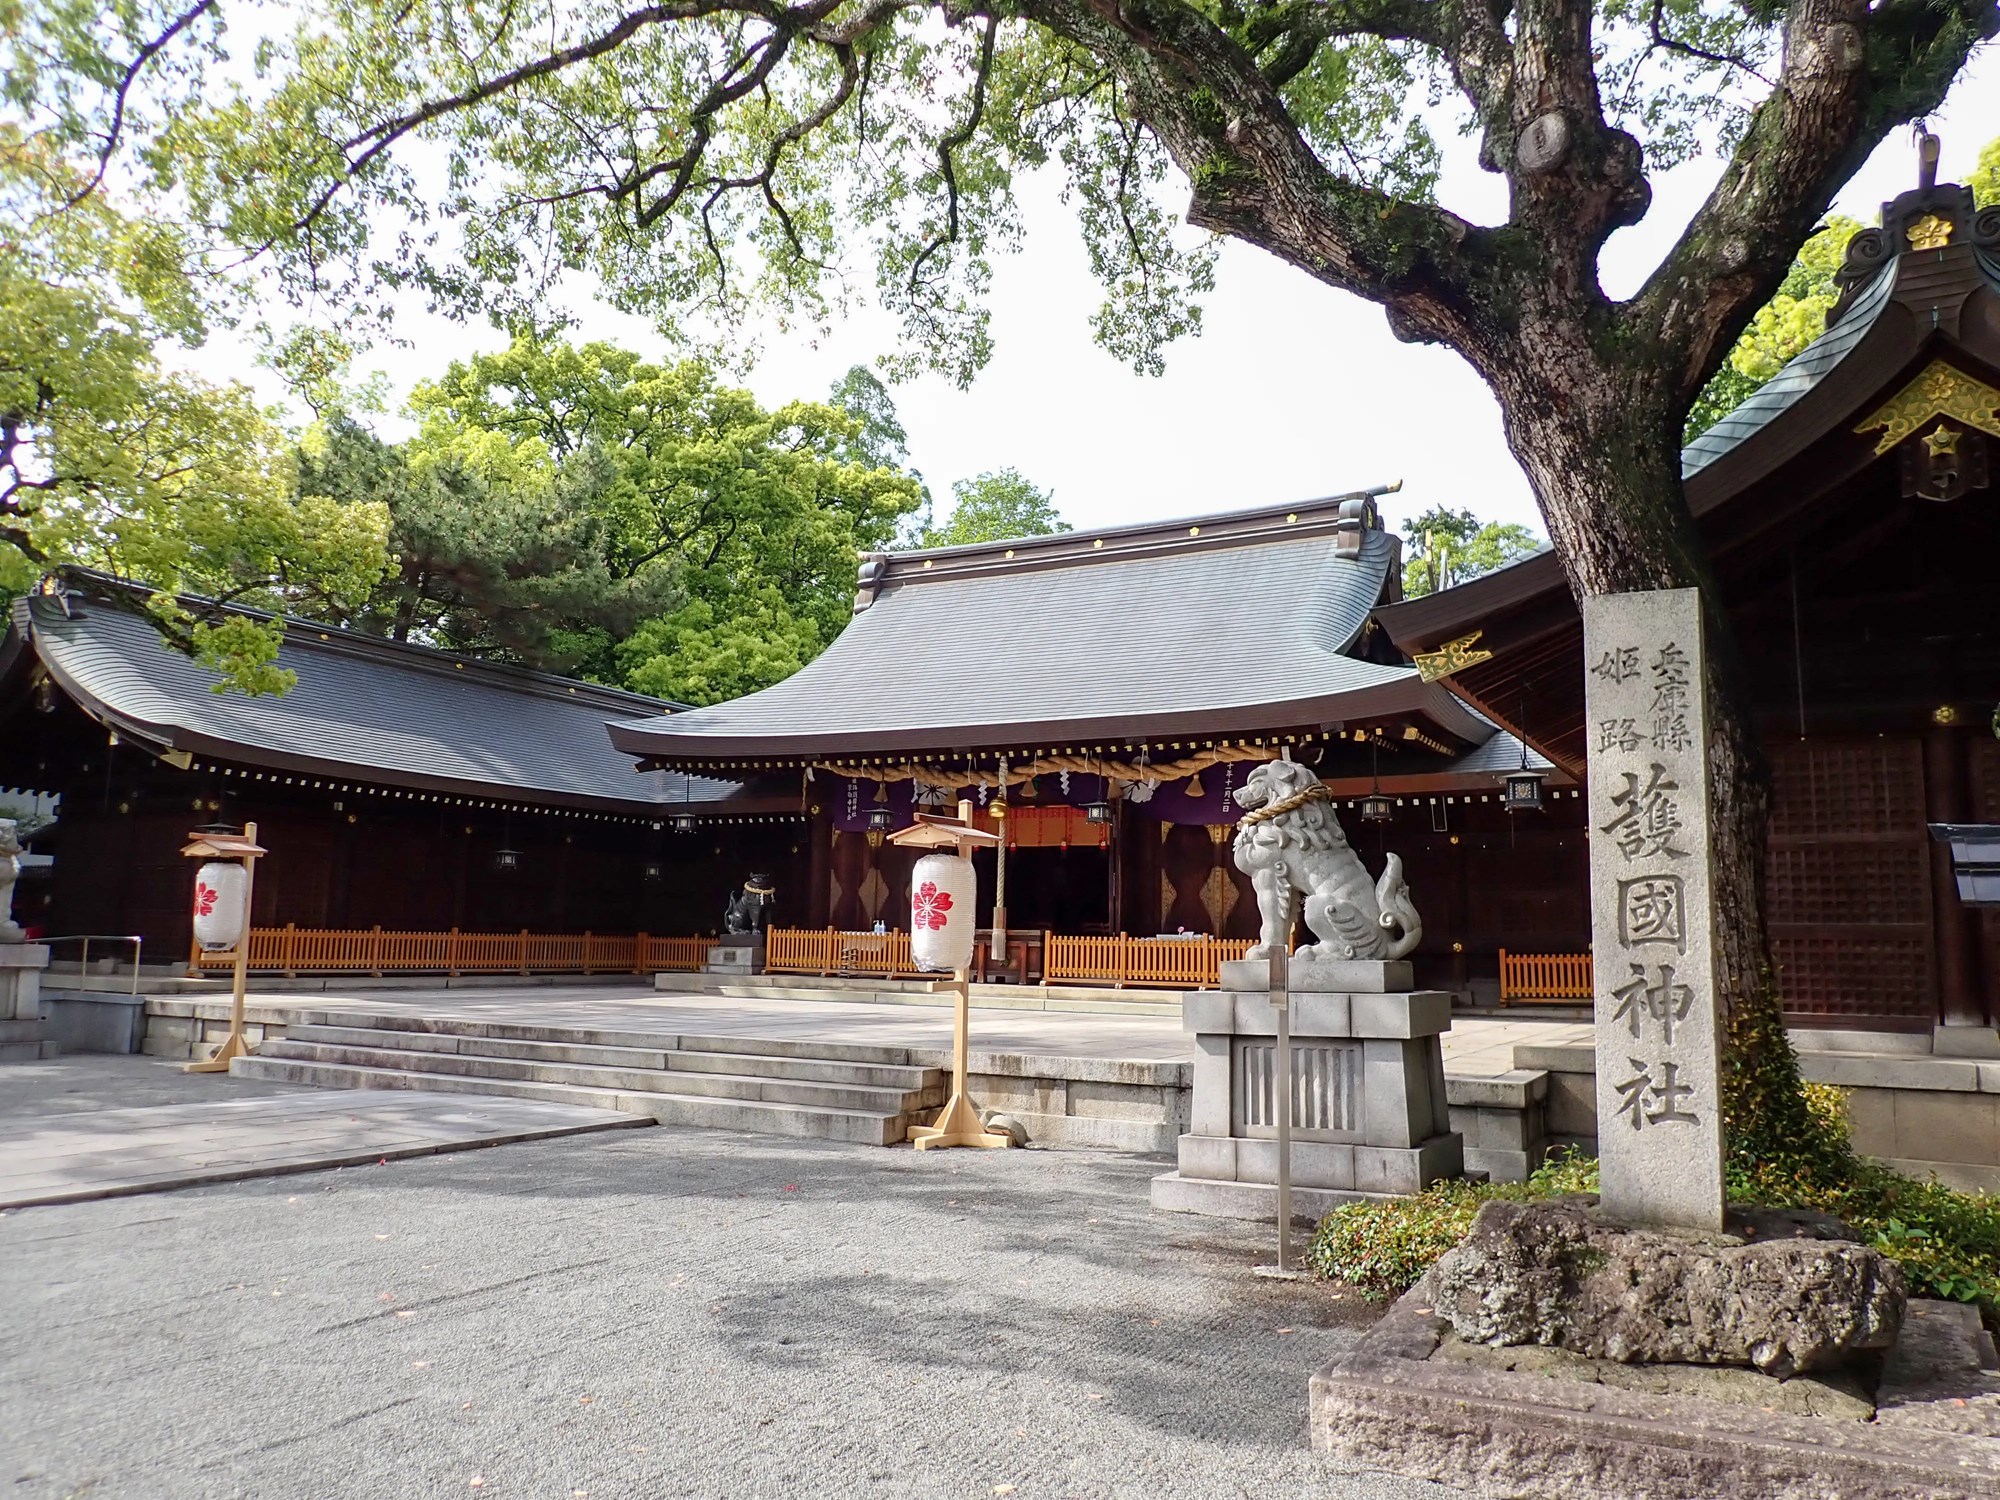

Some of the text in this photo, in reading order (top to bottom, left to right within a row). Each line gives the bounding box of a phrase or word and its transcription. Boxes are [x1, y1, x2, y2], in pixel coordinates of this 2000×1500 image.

[1648, 641, 1692, 754] 兵庫縣
[1599, 762, 1702, 1131] 護國神社
